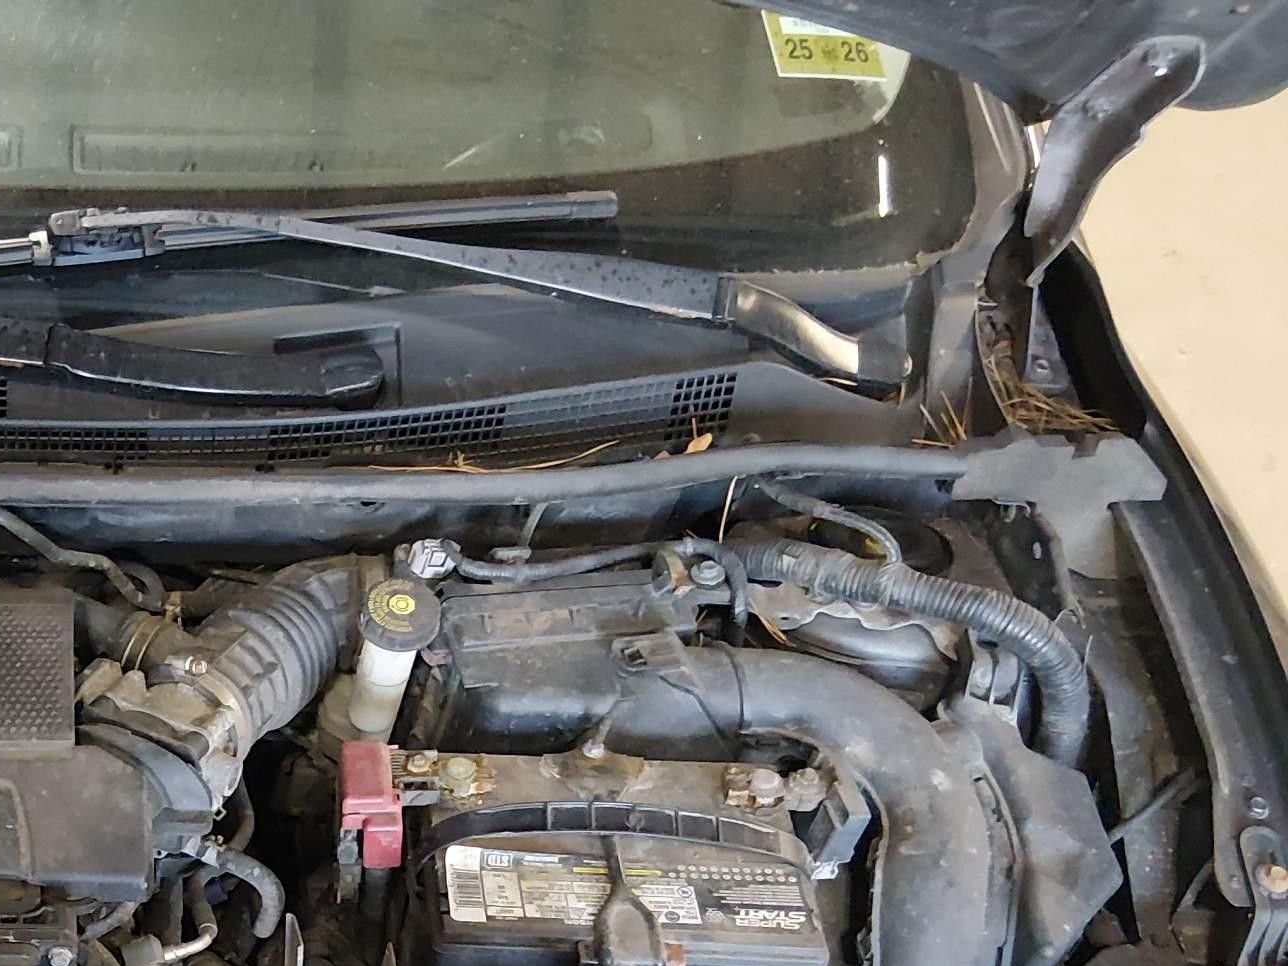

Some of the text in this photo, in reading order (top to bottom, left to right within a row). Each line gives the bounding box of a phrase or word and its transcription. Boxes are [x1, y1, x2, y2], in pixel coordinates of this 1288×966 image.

[784, 39, 869, 63] 25 26
[734, 909, 807, 922] START
[735, 918, 800, 930] SUPER
